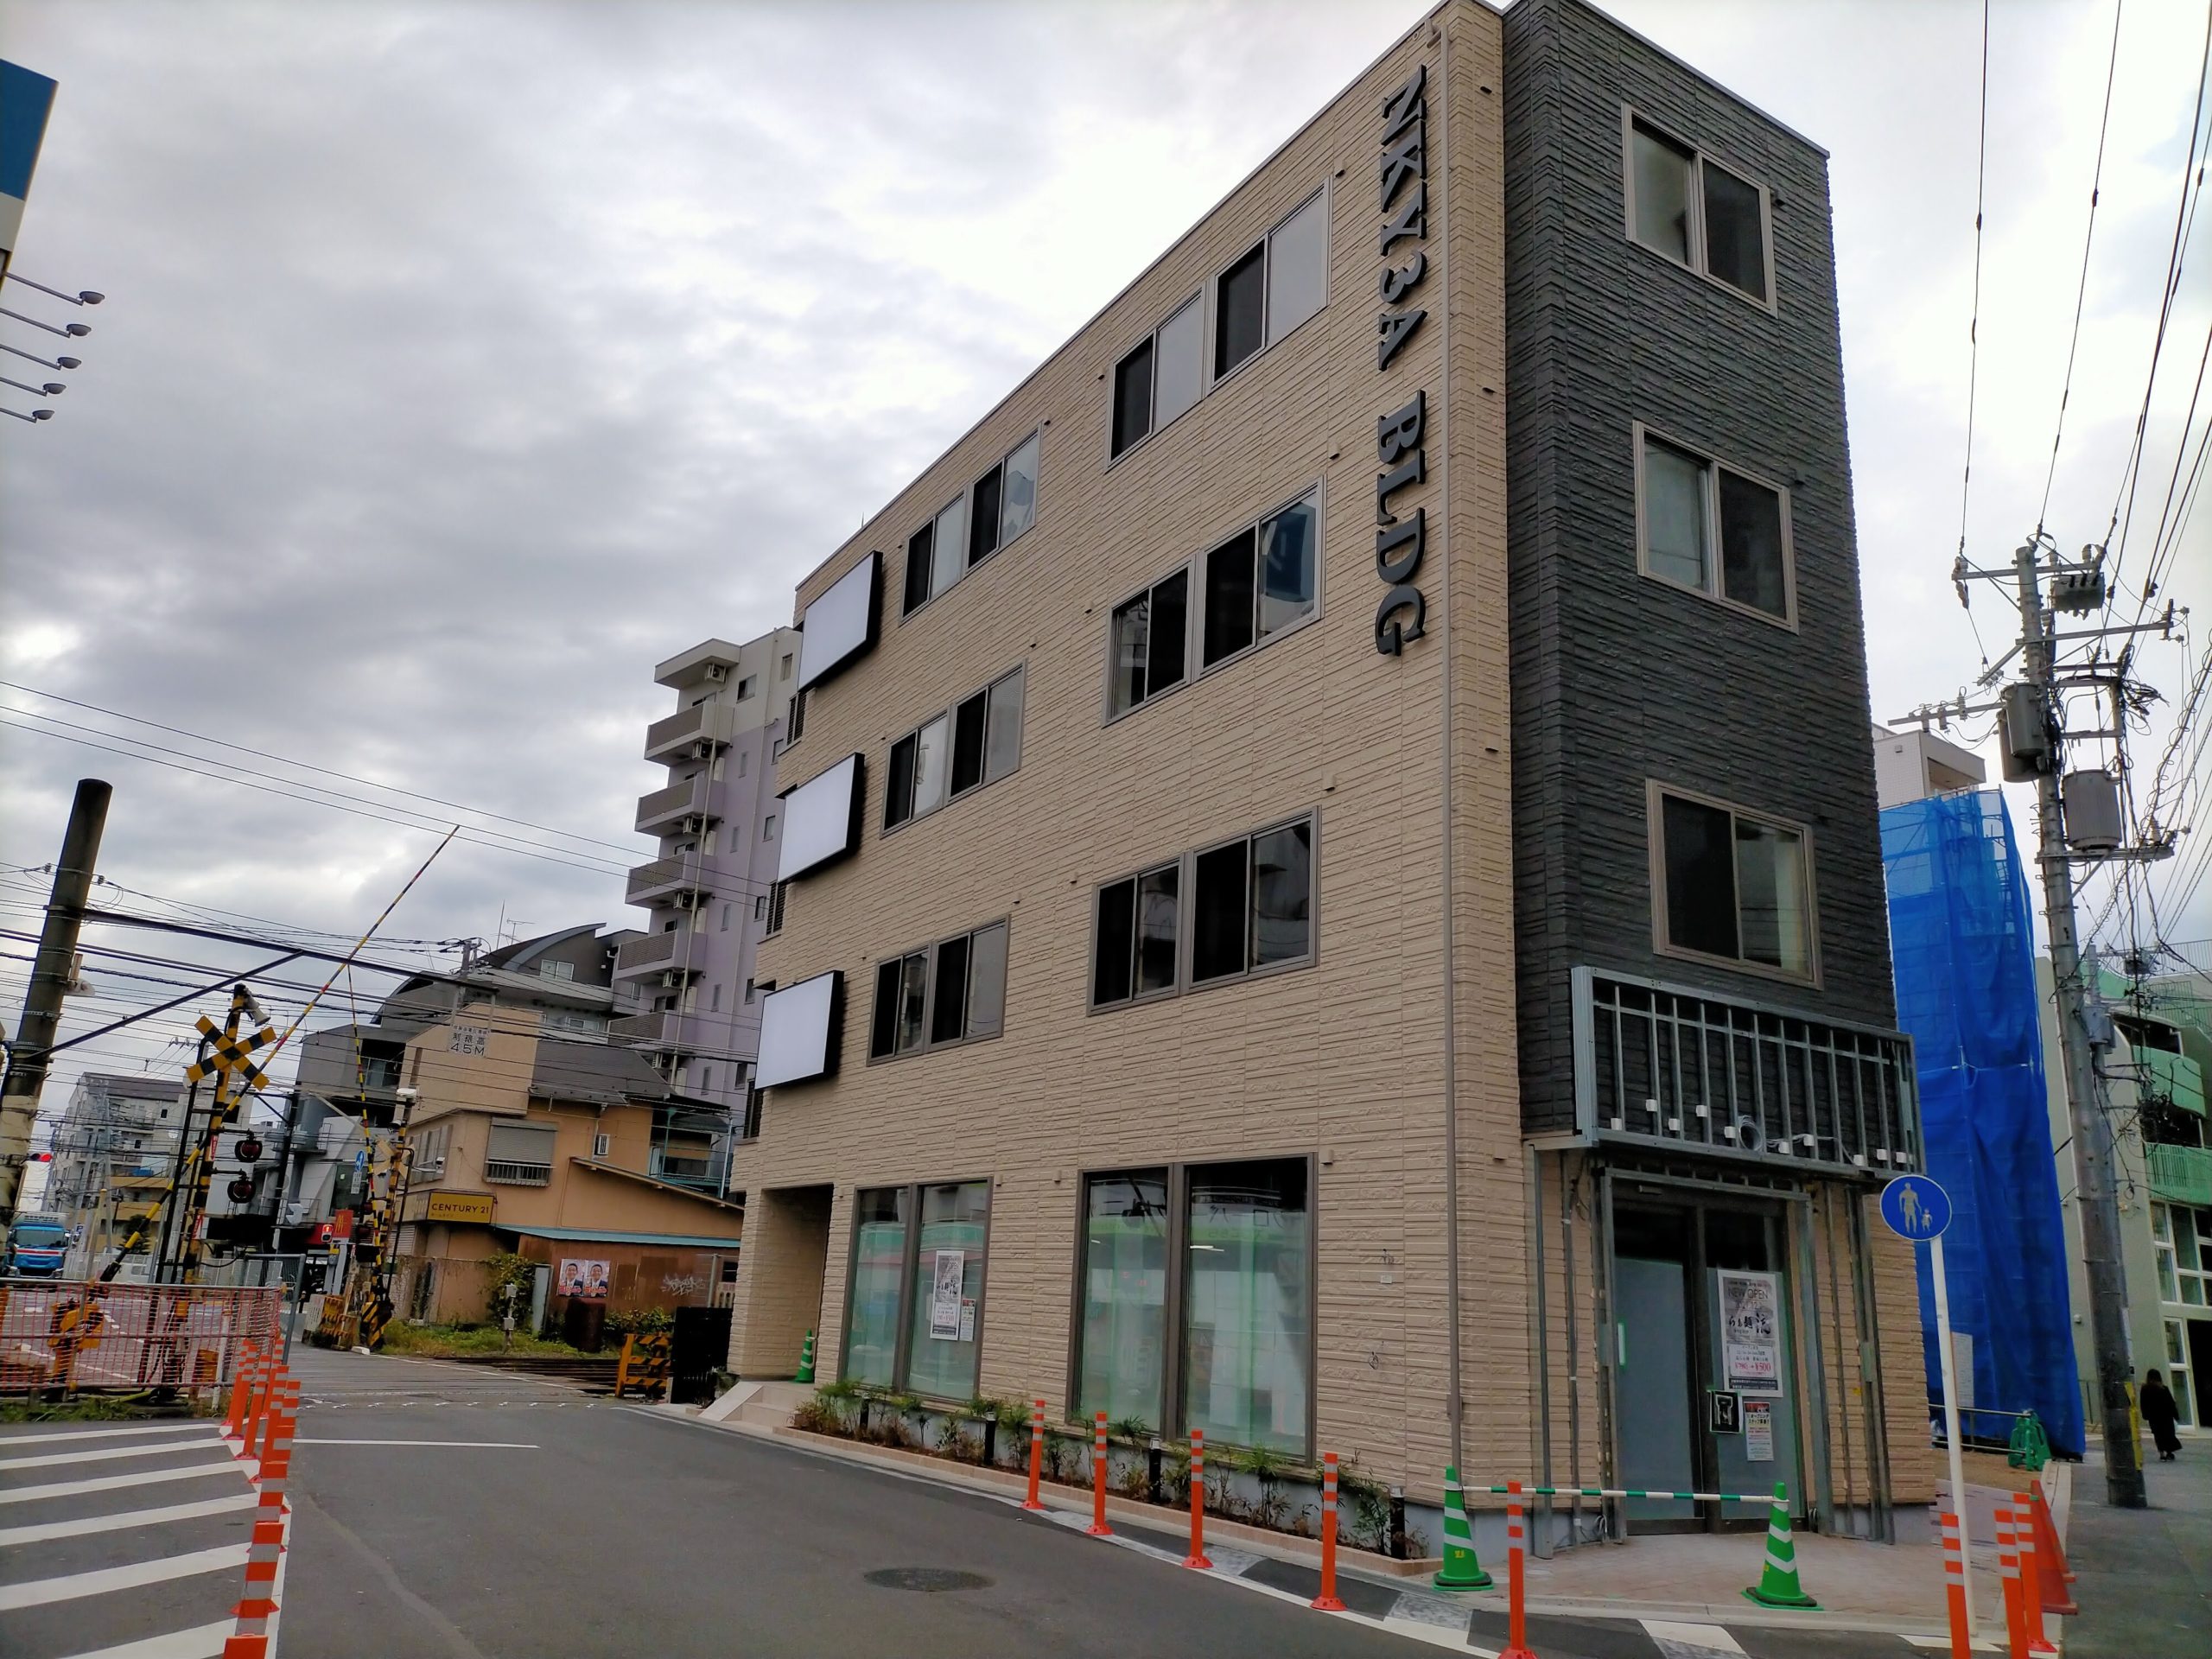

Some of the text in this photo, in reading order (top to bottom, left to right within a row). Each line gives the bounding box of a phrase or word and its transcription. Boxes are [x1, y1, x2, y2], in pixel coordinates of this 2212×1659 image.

[1375, 64, 1427, 657] NKY3A BLDG
[431, 1203, 479, 1214] CENTURY
[1747, 1288, 1769, 1300] OPEN
